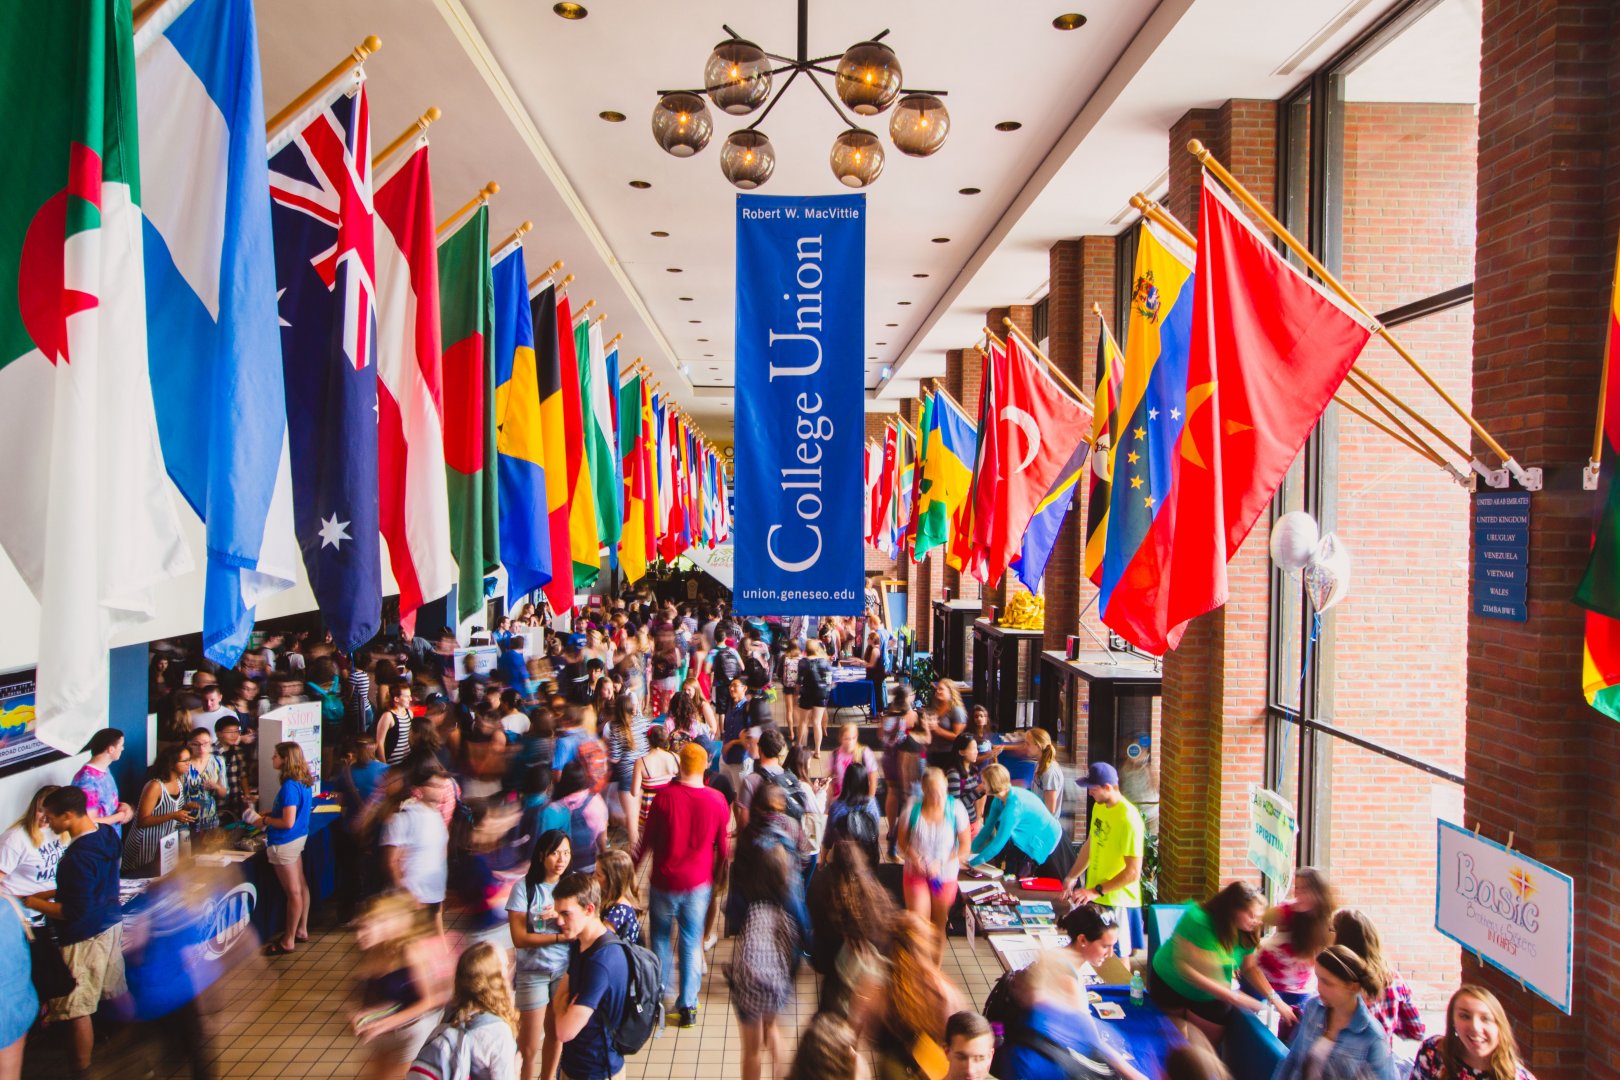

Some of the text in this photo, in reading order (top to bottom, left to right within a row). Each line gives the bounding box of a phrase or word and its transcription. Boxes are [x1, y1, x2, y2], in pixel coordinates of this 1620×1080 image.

[742, 207, 859, 219] Robert W. MacVittie
[767, 234, 834, 572] College Union
[1476, 498, 1493, 506] UNITED
[1484, 552, 1518, 560] VENEZUELA
[1486, 569, 1514, 578] VIETNAM
[743, 588, 855, 601] union.geneseo.edu
[1490, 588, 1508, 596] WALES
[1482, 605, 1515, 615] ZIMBABWE
[1456, 851, 1539, 933] Basic
